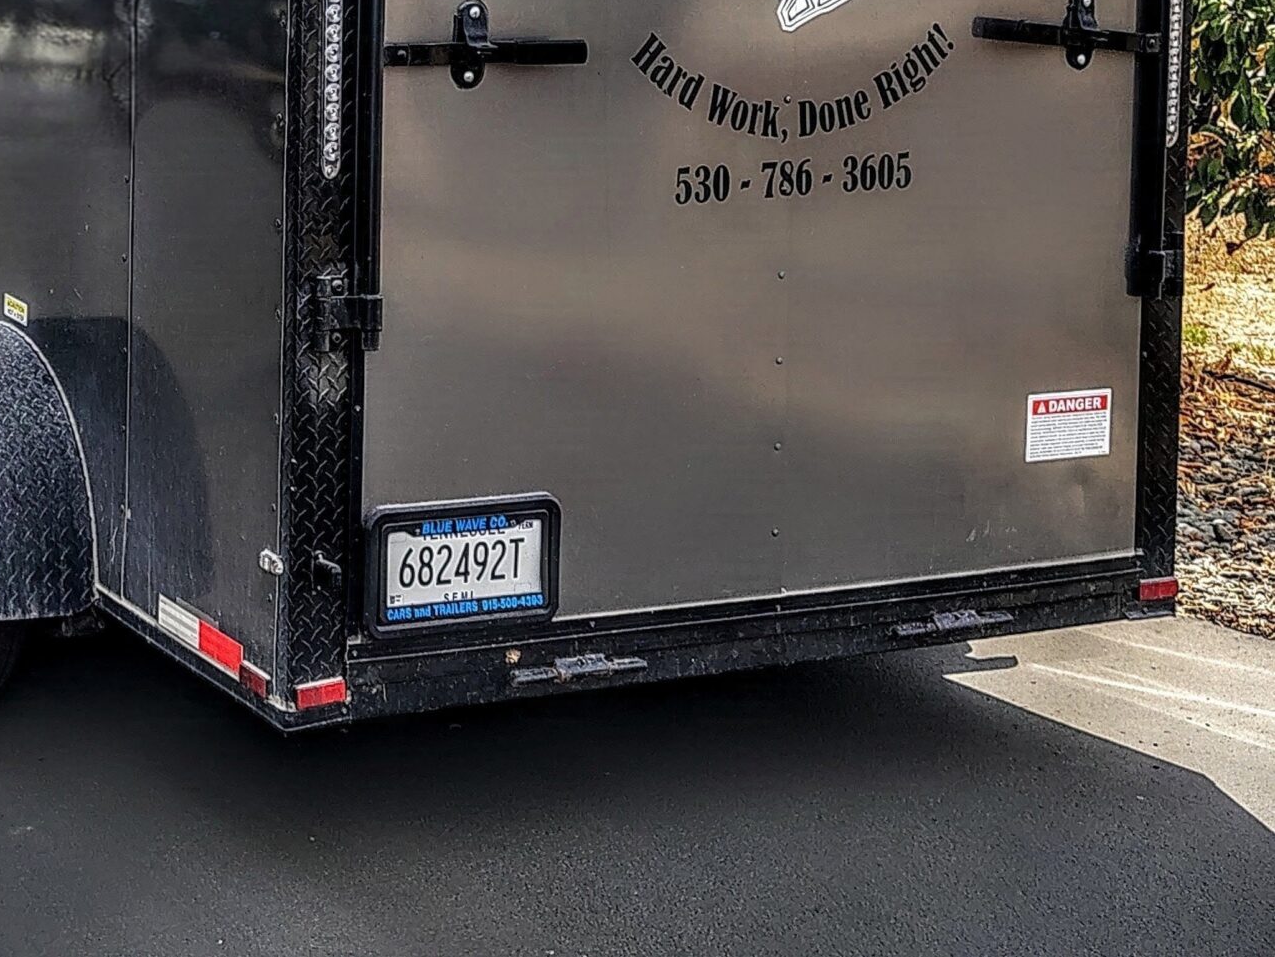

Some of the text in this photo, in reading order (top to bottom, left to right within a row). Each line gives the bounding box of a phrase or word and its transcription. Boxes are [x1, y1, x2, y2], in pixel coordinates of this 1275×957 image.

[630, 22, 955, 143] Hard Work, Done Right!
[674, 164, 730, 205] 530
[761, 158, 812, 199] 786
[842, 151, 911, 193] 3605
[1048, 397, 1102, 413] DANGER
[422, 515, 509, 534] BLUE WAVE CO.
[399, 537, 525, 588] 682492T
[387, 607, 412, 621] CARS
[433, 600, 479, 616] TRAILERS
